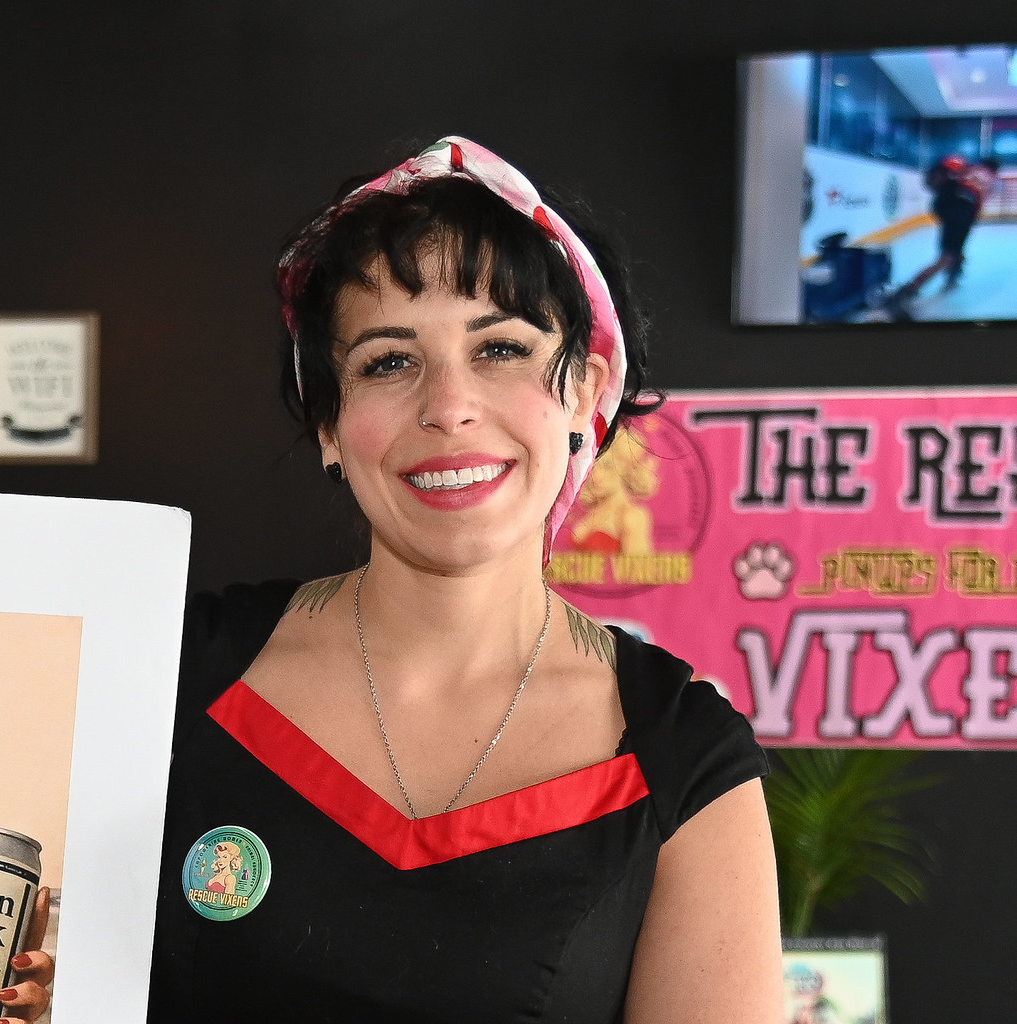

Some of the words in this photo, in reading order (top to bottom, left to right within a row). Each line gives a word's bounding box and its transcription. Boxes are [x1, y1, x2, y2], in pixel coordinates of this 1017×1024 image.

[689, 406, 872, 509] THE
[188, 888, 218, 904] RESCUE
[220, 892, 249, 908] VIXENS
